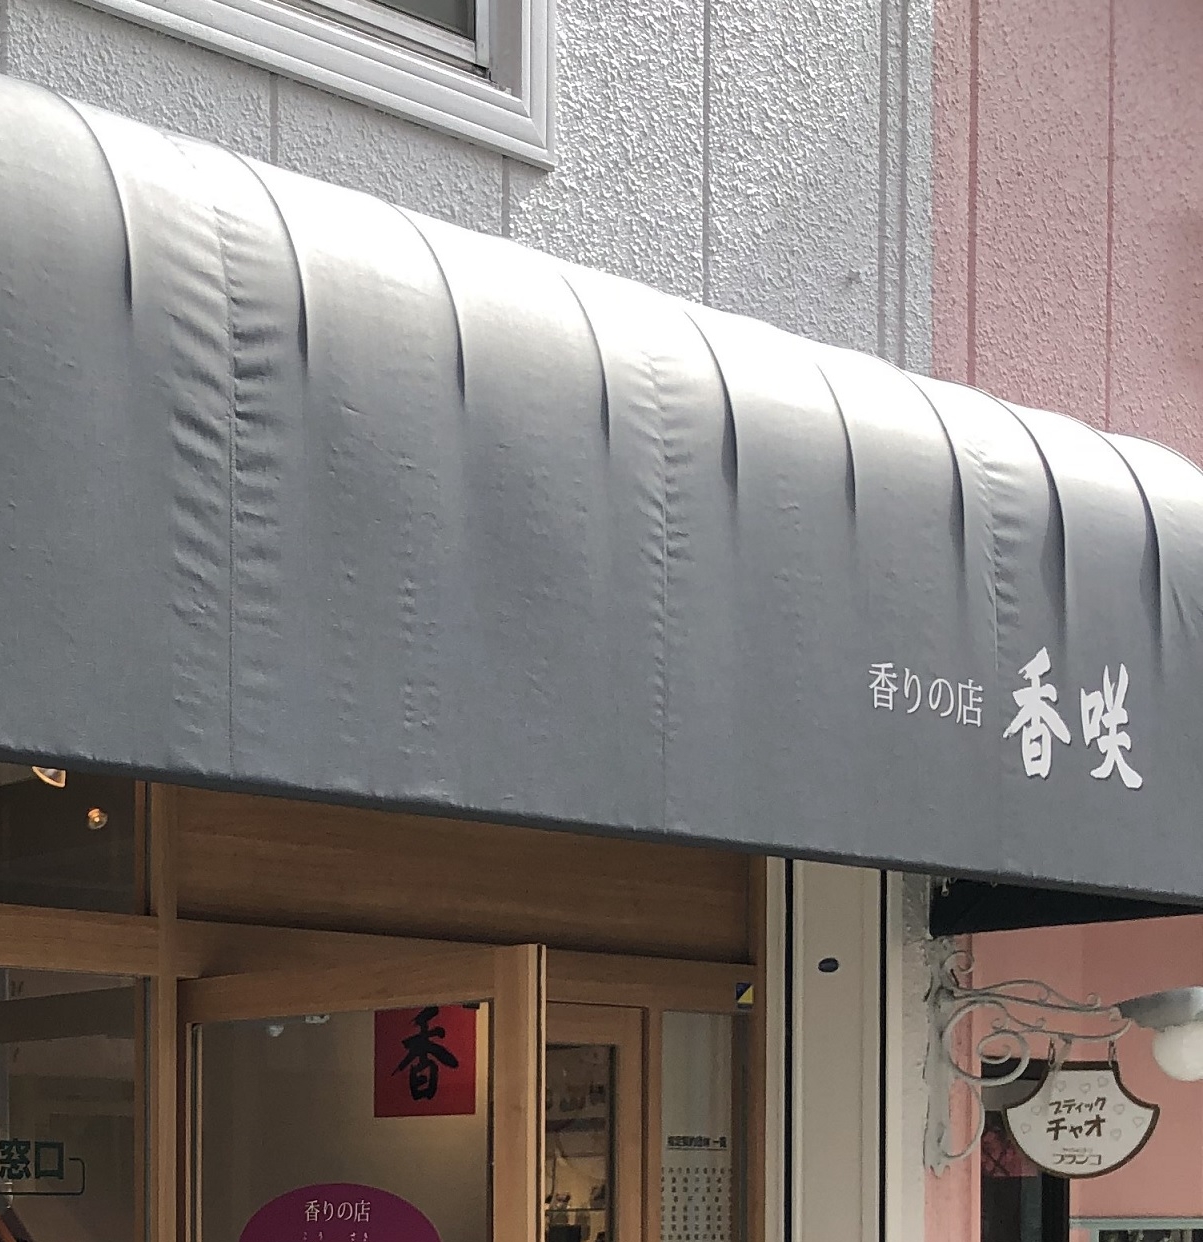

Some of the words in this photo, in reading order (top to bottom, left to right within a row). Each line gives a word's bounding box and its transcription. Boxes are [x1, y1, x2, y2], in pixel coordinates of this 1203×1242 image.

[868, 662, 984, 728] 香りの店
[1003, 646, 1143, 789] 香咲
[391, 1006, 459, 1101] 香
[1049, 1097, 1107, 1115] スティック
[1047, 1114, 1106, 1141] チャオ
[304, 1200, 371, 1223] 香りの店
